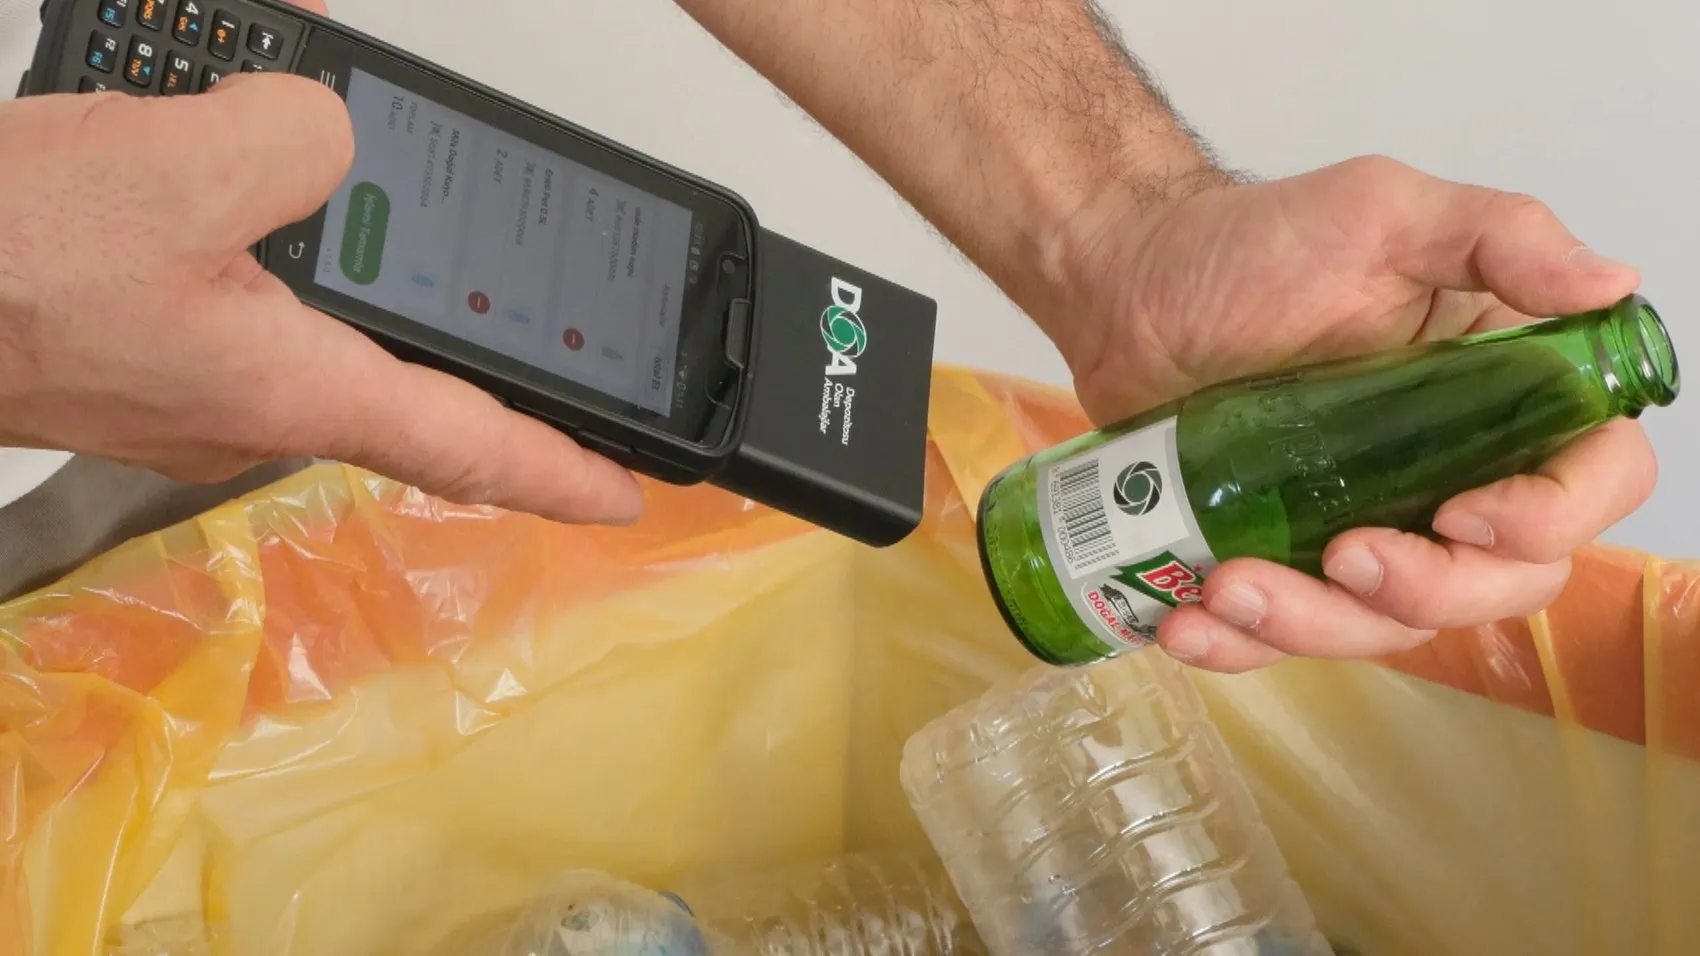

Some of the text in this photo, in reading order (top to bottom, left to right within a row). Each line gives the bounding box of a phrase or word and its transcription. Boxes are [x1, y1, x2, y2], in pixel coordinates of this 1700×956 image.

[185, 1, 199, 15] 4
[221, 19, 235, 29] 1
[104, 37, 117, 51] F2
[138, 43, 152, 57] 8
[175, 57, 189, 72] 5
[391, 95, 404, 111] 10
[496, 148, 508, 159] 2
[834, 383, 843, 407] Olan
[819, 377, 833, 434] Ambalajlar
[842, 387, 855, 445] Depozitosu
